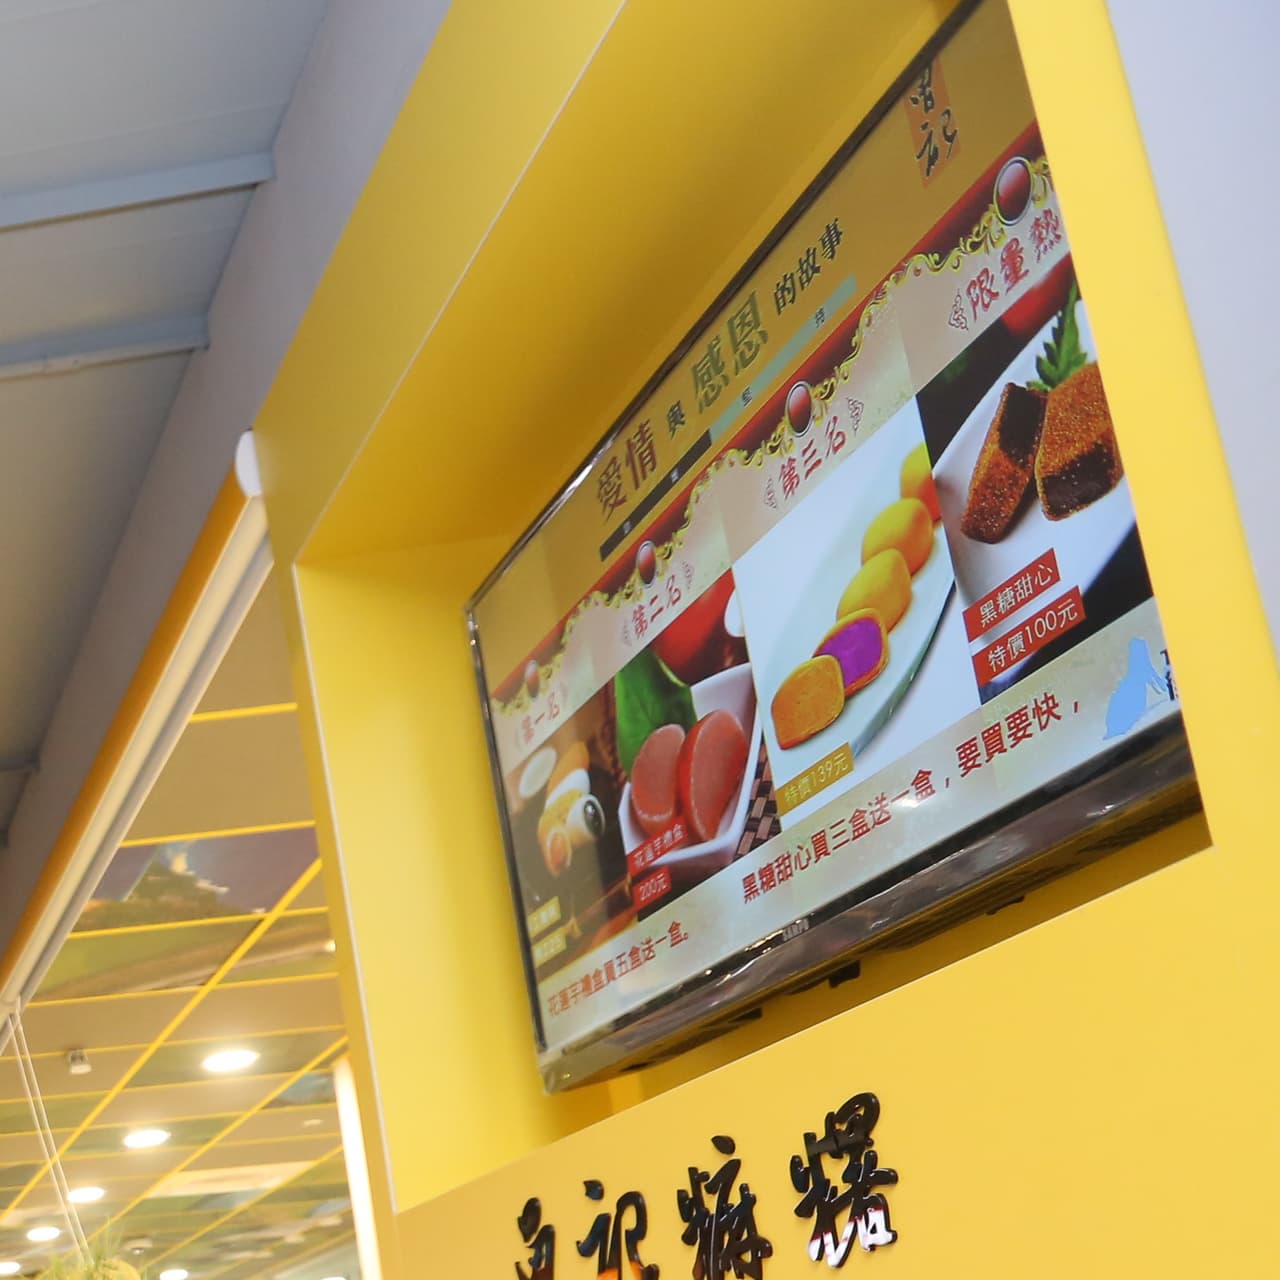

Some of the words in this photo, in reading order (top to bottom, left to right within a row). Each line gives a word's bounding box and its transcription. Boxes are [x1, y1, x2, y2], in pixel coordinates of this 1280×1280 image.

[596, 416, 658, 523] 愛情
[692, 289, 770, 415] 感恩
[774, 217, 844, 316] 的故事
[779, 415, 845, 502] 第三名
[631, 573, 682, 639] 第二名
[980, 563, 1053, 628] 黑糖甜心
[988, 597, 1079, 673] 特價100元
[784, 752, 849, 804] 特價139元
